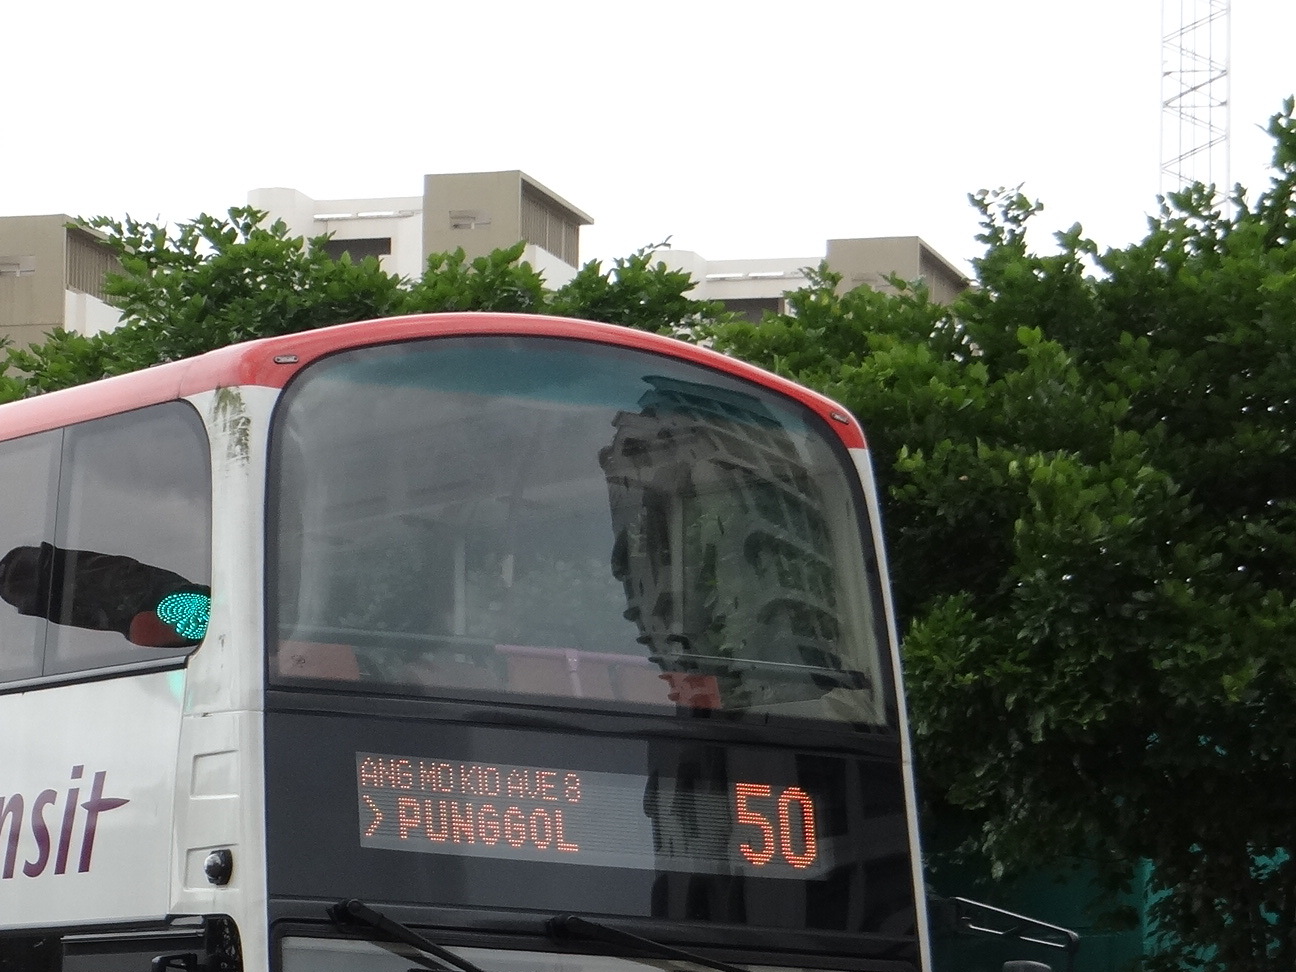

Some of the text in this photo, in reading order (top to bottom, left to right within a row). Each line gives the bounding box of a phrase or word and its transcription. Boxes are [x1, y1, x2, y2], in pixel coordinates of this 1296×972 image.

[361, 757, 581, 803] ANG MO KIO AVE 8
[397, 797, 580, 853] PUNGGOL
[735, 782, 818, 869] 50
